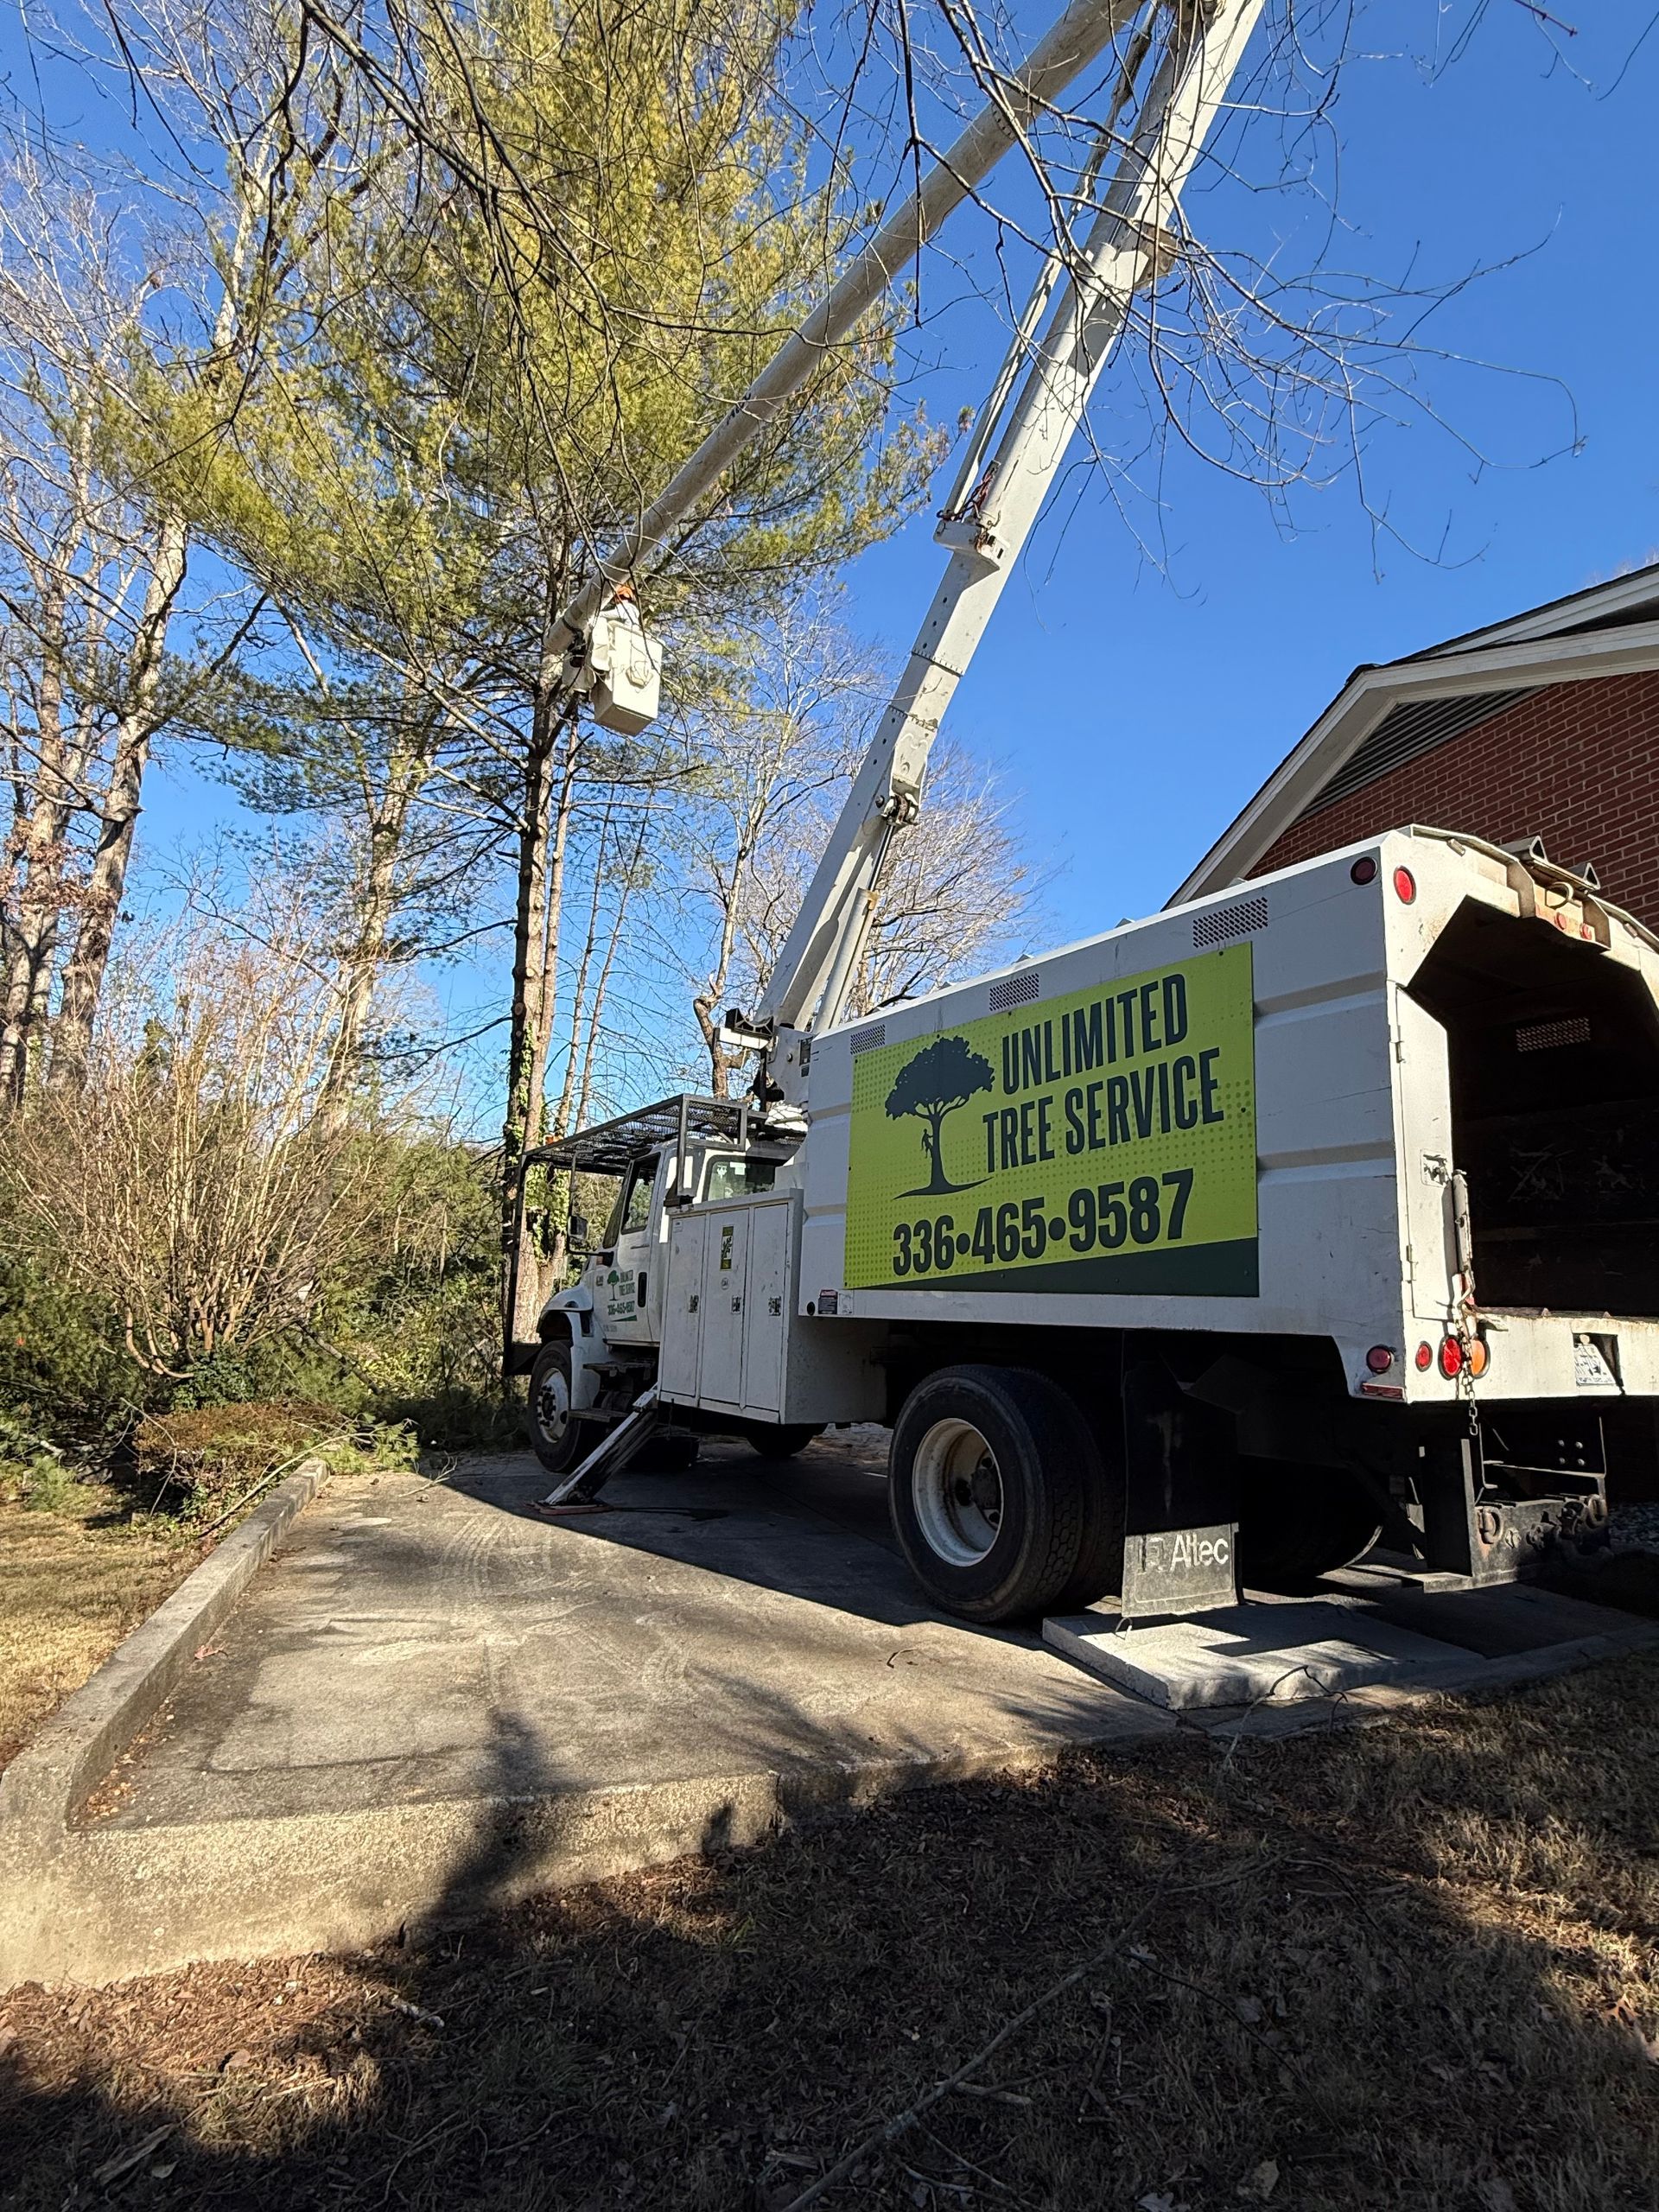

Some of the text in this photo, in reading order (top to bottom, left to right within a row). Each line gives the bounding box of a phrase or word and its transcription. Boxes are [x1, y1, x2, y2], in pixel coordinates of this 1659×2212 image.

[1001, 973, 1188, 1096] UNLIMITED
[982, 1046, 1224, 1173] TREE SERVICE
[1170, 1532, 1229, 1573] Altec
